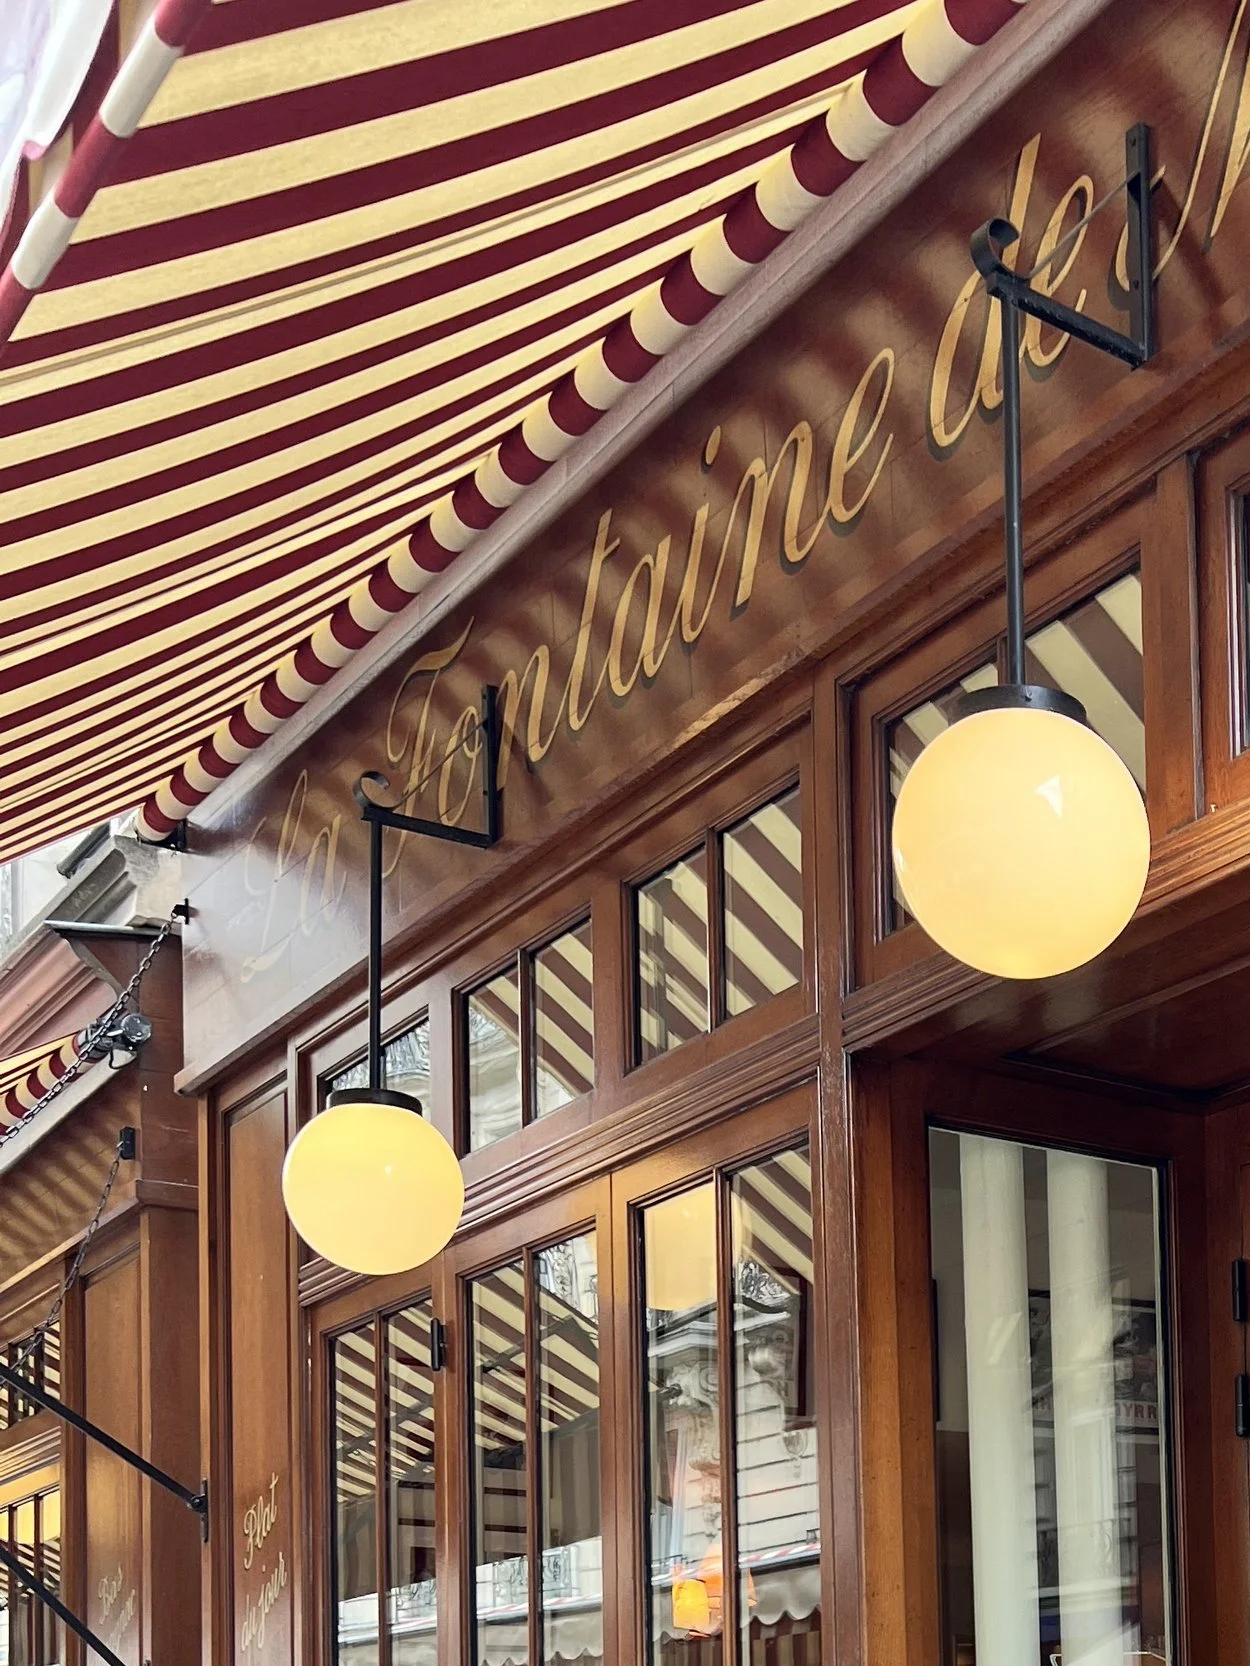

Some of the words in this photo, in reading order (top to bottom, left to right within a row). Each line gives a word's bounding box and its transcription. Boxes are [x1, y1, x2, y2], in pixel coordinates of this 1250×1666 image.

[241, 768, 347, 984] La
[382, 347, 895, 879] Fontaine
[930, 132, 1094, 447] de
[244, 1472, 278, 1569] Plat
[242, 1594, 257, 1651] du
[258, 1552, 287, 1649] jour
